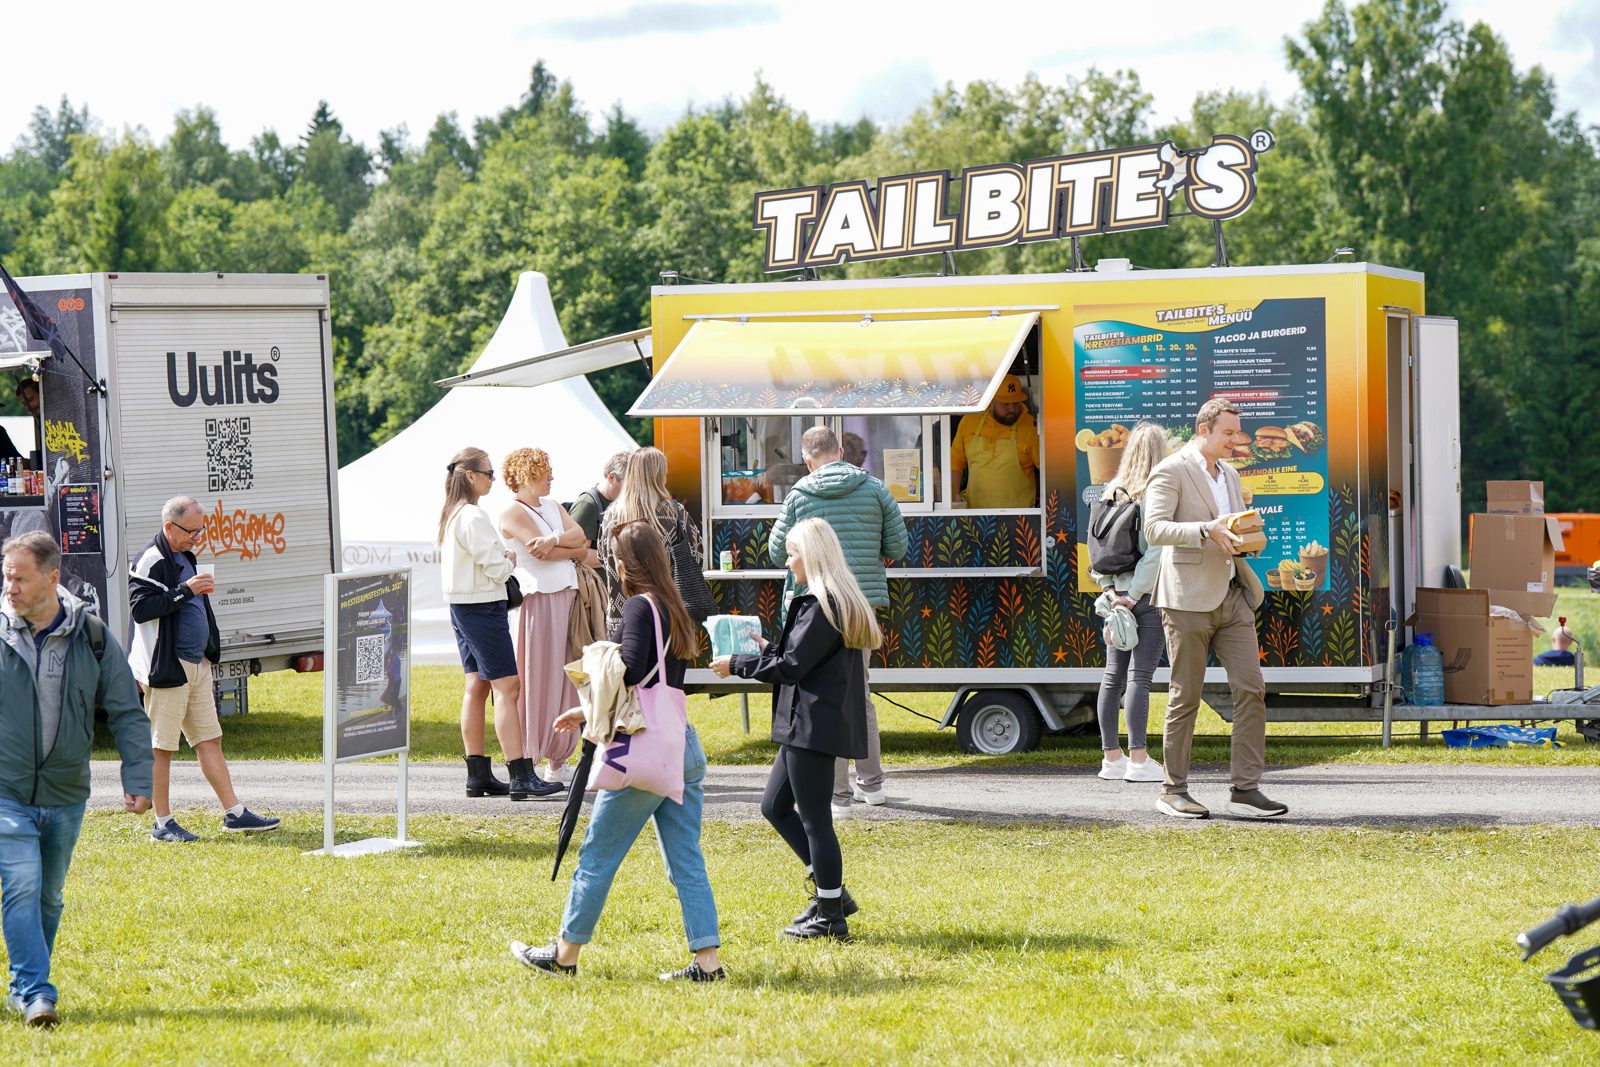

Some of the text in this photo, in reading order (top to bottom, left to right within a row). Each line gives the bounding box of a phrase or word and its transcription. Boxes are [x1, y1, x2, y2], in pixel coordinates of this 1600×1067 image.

[757, 137, 1254, 268] TAILBITE'S
[1157, 304, 1224, 321] TAILBITE'S
[1208, 309, 1253, 326] MENÜÜ
[1214, 326, 1307, 344] TACOD JA BURGERID
[166, 350, 280, 407] Uulits
[230, 662, 247, 676] BSX
